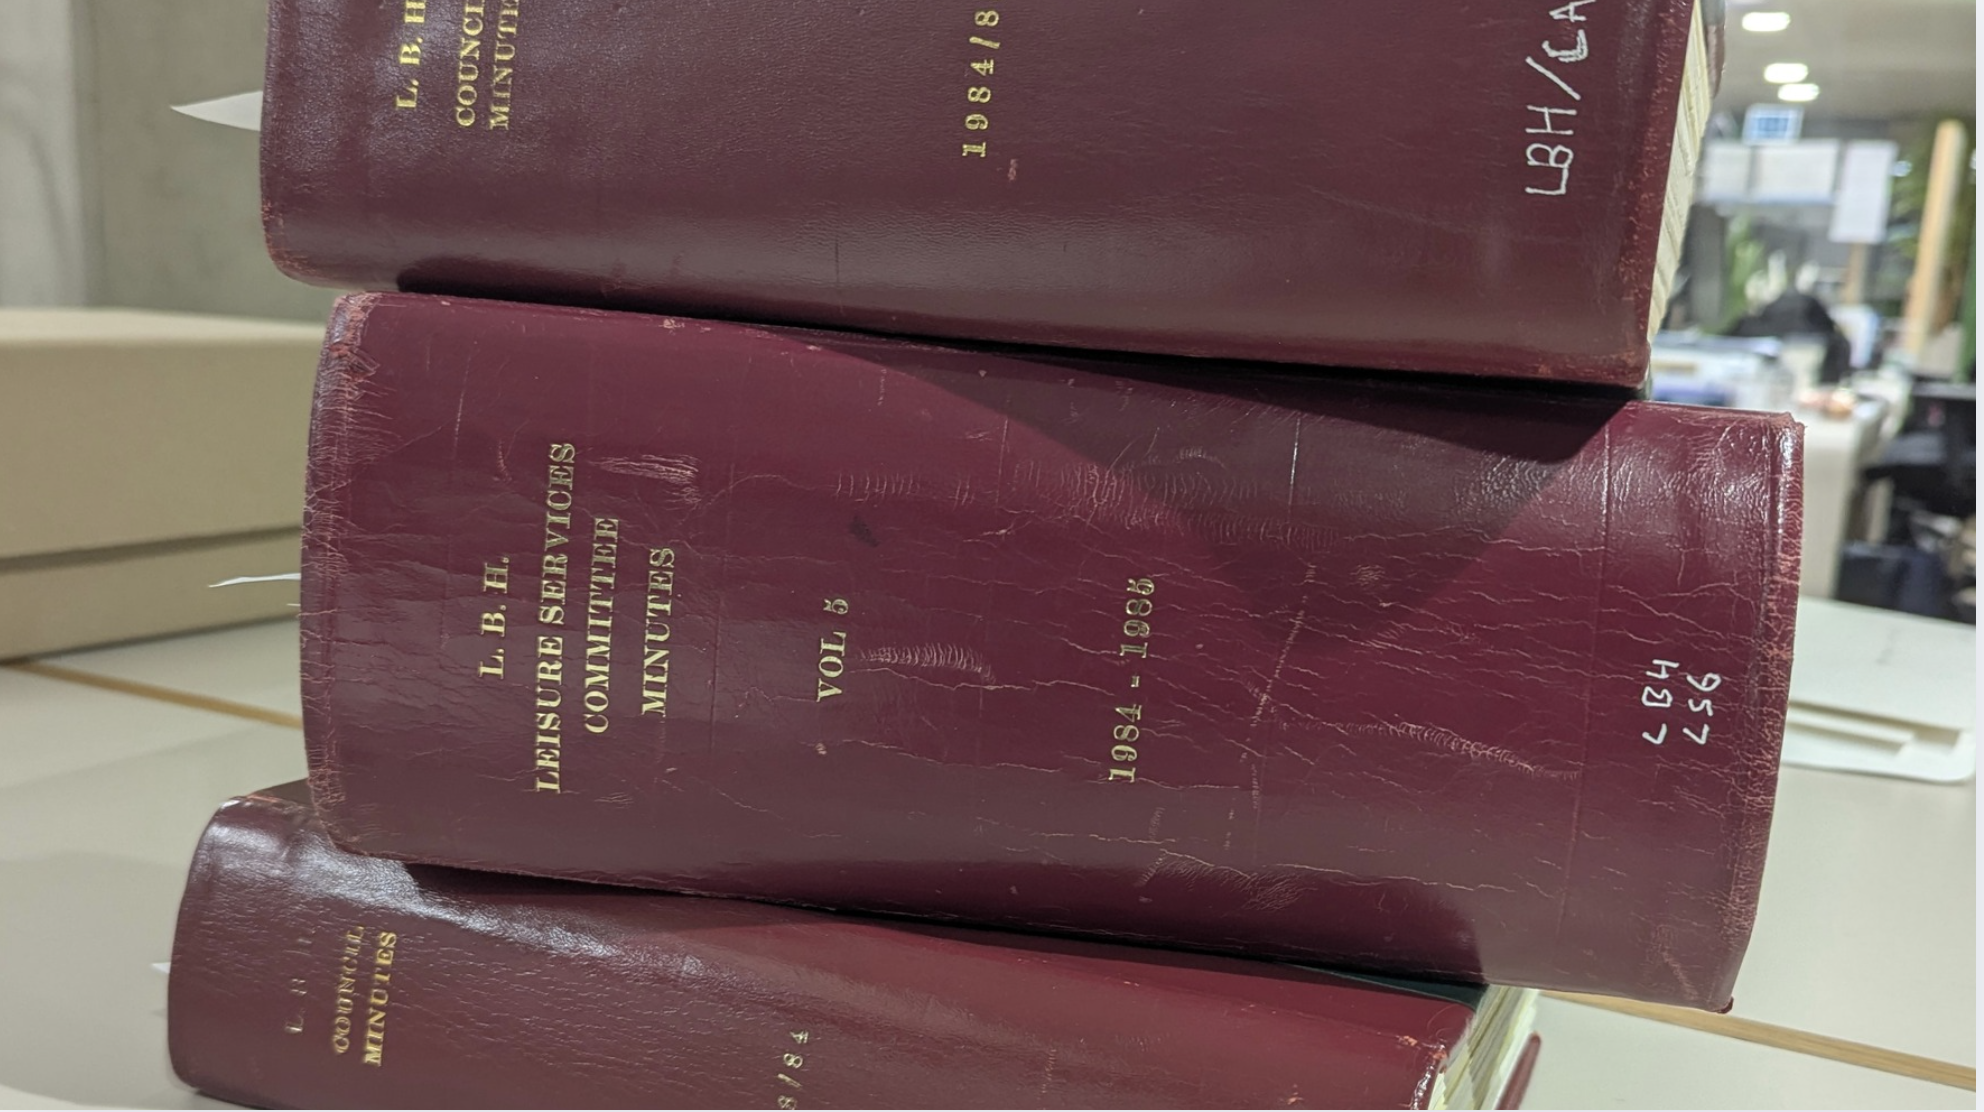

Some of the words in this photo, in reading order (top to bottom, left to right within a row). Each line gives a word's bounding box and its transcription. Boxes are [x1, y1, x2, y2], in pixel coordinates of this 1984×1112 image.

[399, 37, 423, 66] B.
[962, 10, 1001, 158] 1984/8
[396, 79, 419, 110] L.
[538, 443, 576, 625] SERVICES
[483, 556, 510, 593] H.
[823, 599, 849, 615] 5
[480, 604, 507, 637] B.
[584, 517, 619, 733] COMMITTEE
[641, 547, 675, 717] MINUTES
[1119, 578, 1155, 658] 1985
[479, 648, 505, 679] L.
[816, 631, 847, 702] VOL
[535, 635, 563, 794] LEISURE
[1108, 703, 1142, 783] 1984
[332, 926, 365, 1054] COUNCIL
[363, 931, 397, 1067] MINUTES
